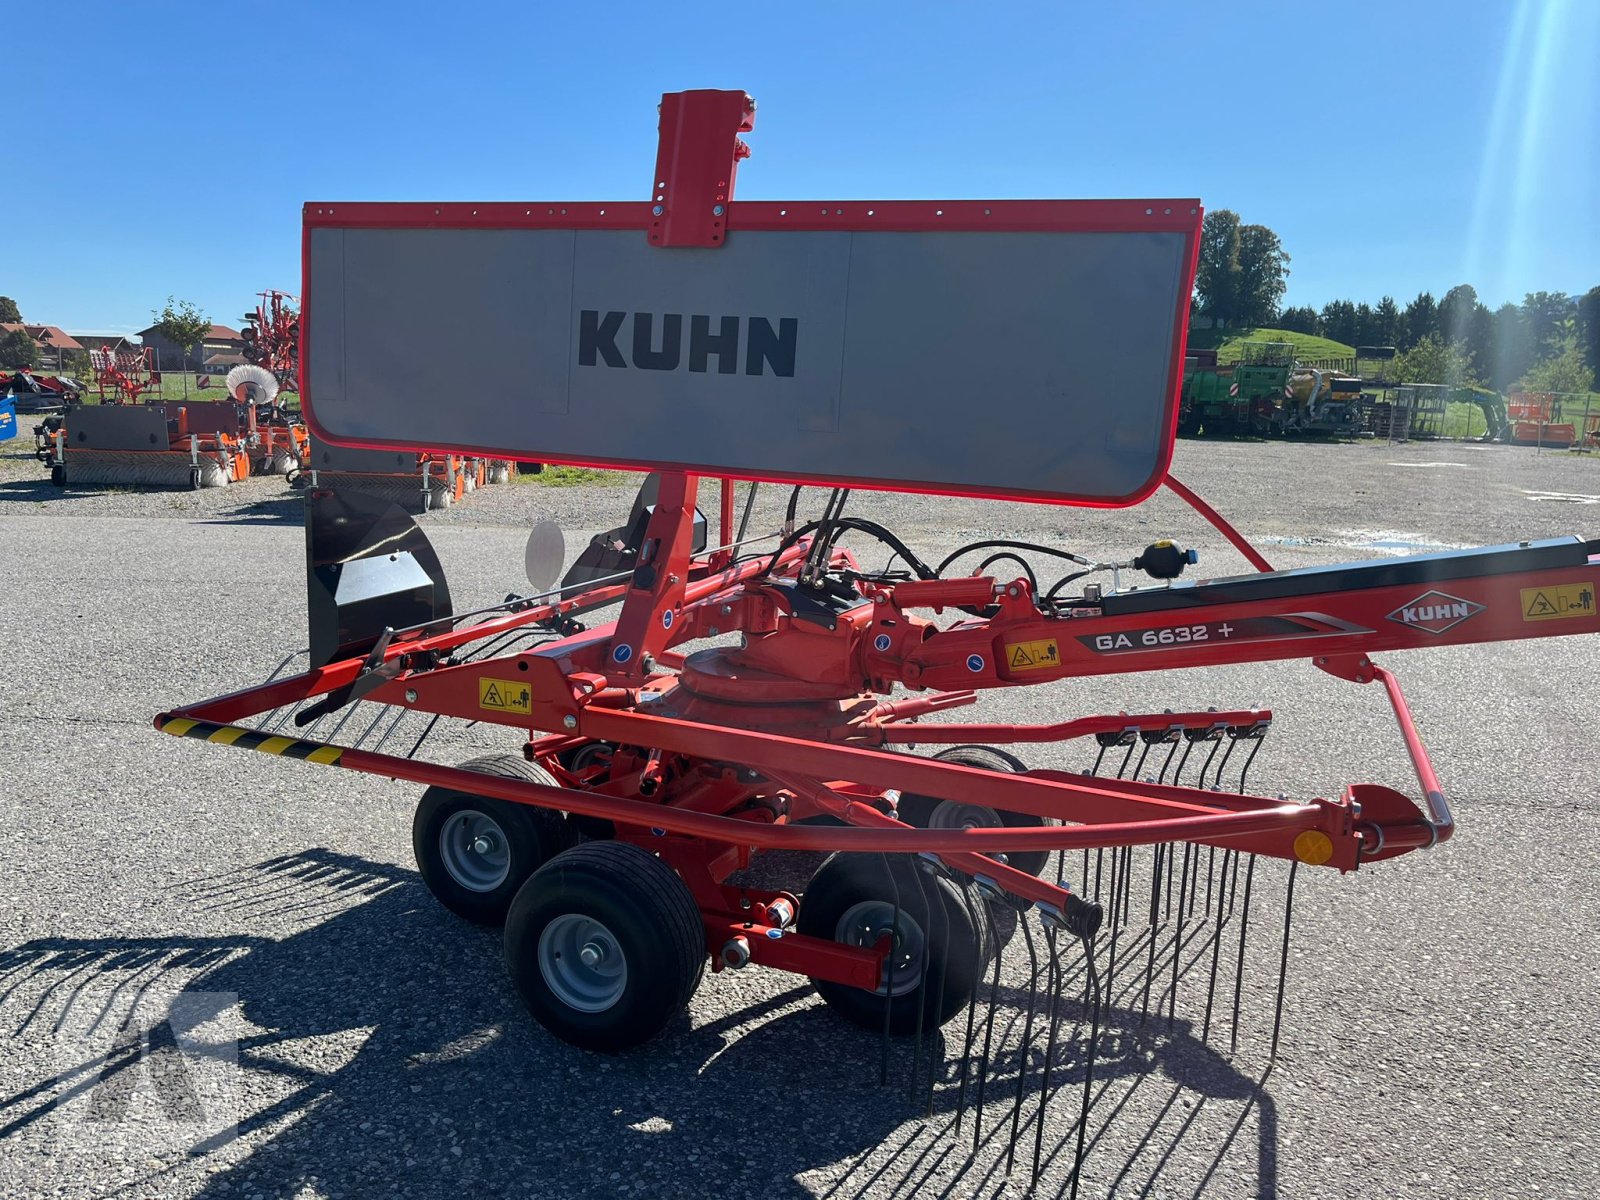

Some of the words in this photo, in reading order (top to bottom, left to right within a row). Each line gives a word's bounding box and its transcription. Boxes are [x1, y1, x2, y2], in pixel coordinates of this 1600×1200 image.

[579, 310, 798, 377] KUHN
[1402, 603, 1469, 623] KUHN
[1095, 634, 1133, 651] GA
[1141, 625, 1209, 646] 6632
